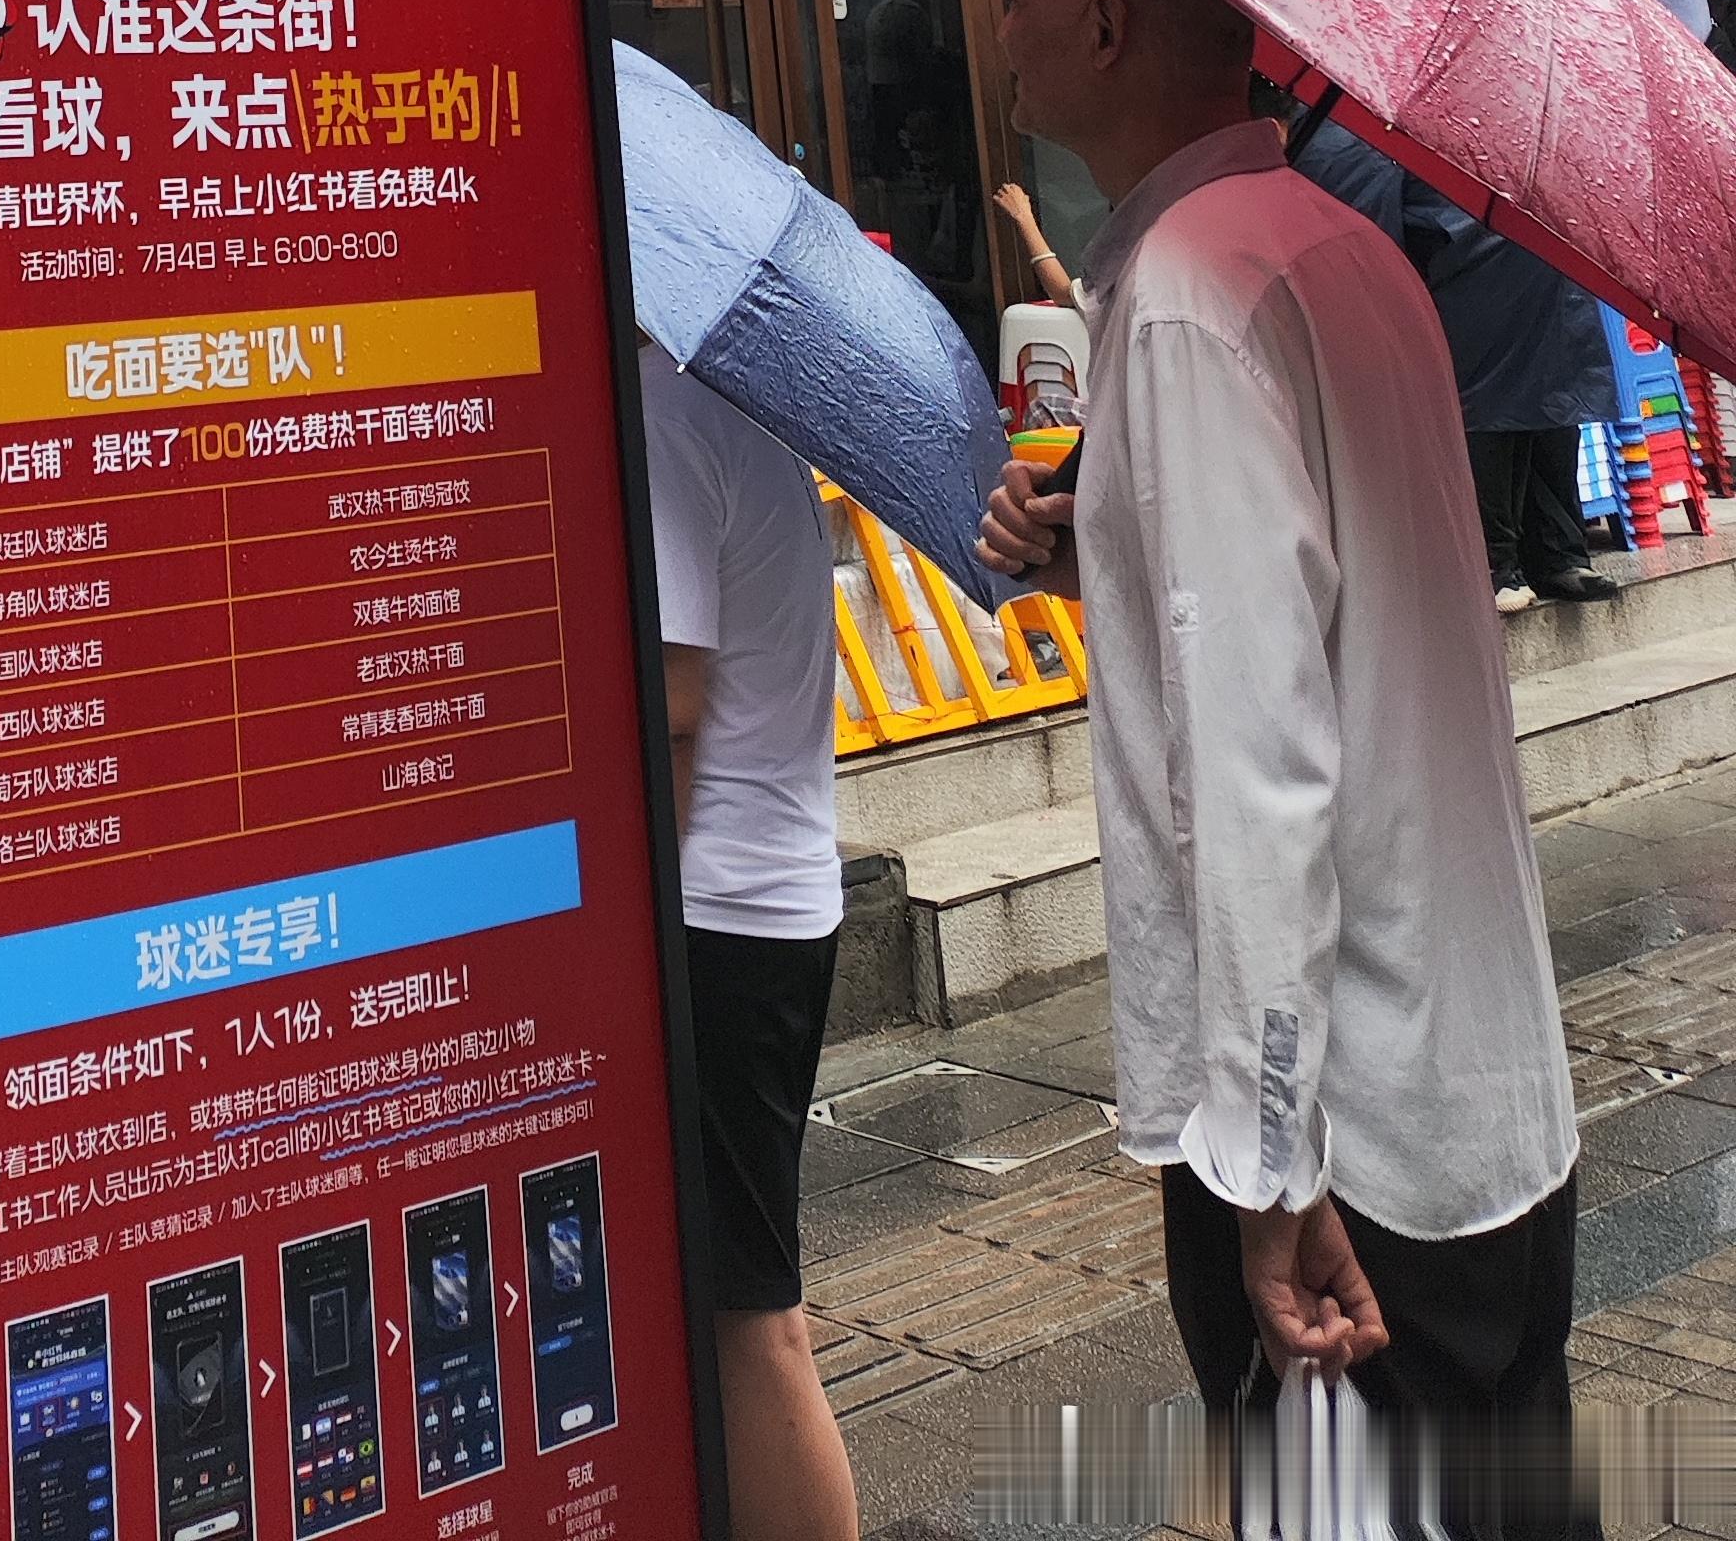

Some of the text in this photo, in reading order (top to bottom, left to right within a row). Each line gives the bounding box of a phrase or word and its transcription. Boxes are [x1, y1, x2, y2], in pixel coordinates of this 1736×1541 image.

[224, 238, 267, 268] 早上
[274, 230, 398, 264] 6:00-8:00
[327, 478, 471, 520] 武汉热干面鸡冠饺
[350, 534, 457, 571] 农今生烫牛杂
[353, 587, 460, 627] 双黄牛肉面馆
[356, 641, 464, 683] 老武汉热干面
[341, 693, 486, 742] 常青麦香园热干面
[381, 753, 455, 792] 山海食记
[134, 890, 341, 994] 球迷专享！
[4, 964, 470, 1110] 领面条件如下，1人1份，送完即止！
[567, 1460, 594, 1491] 完成
[437, 1499, 493, 1540] 选择球星
